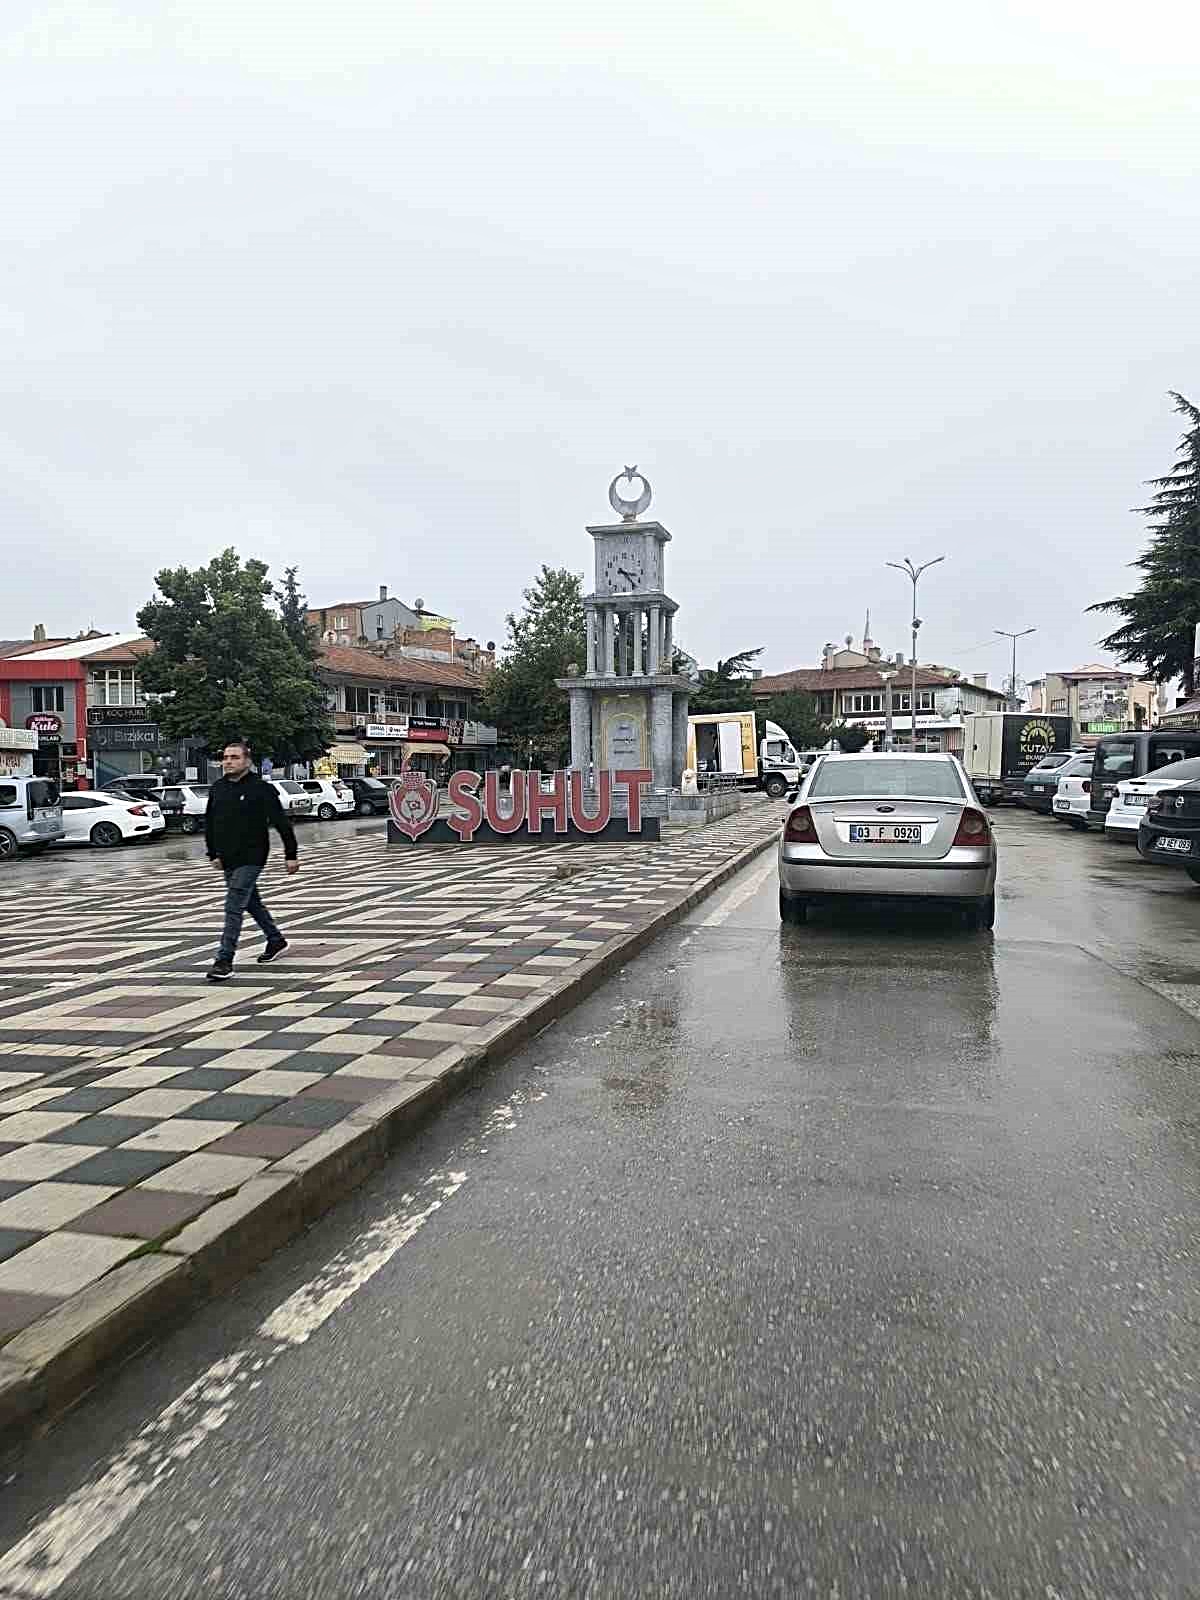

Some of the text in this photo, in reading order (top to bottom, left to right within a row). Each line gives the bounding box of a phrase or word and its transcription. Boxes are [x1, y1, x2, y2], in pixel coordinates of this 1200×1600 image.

[1020, 744, 1053, 753] KUTAY
[447, 769, 654, 841] ŞUHUT
[857, 827, 920, 839] 03 F 0920
